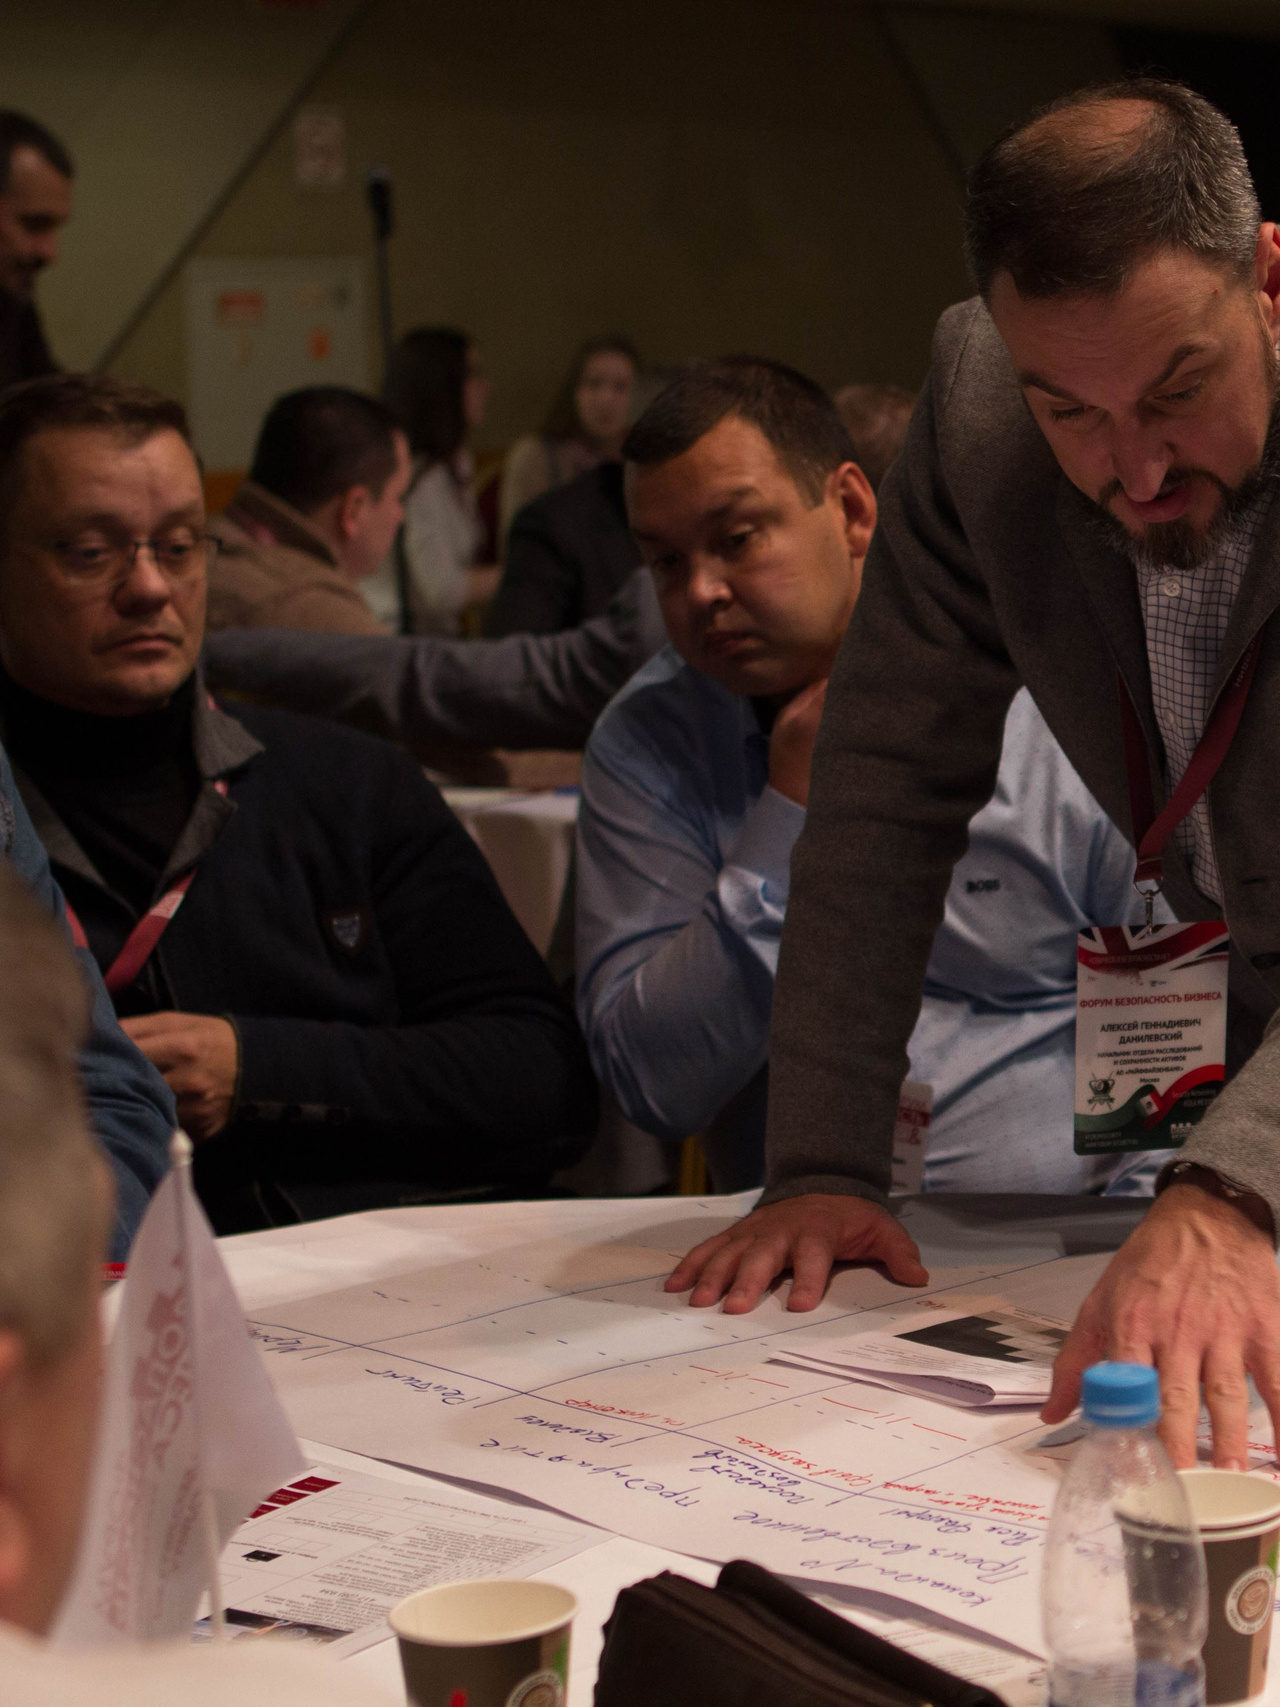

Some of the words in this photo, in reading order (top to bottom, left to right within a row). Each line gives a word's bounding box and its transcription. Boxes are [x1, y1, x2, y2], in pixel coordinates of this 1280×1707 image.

[1080, 999, 1113, 1008] ФОРУМ
[1115, 994, 1182, 1006] БЕЗОПАСНОСТЬ
[1184, 991, 1222, 1001] БИЗНЕСА
[1100, 1021, 1138, 1033] АЛЕКСЕЙ
[1140, 1018, 1202, 1030] ГЕННАДИЕВИЧ
[1119, 1031, 1183, 1045] ДАНИЛЕВСКИЙ
